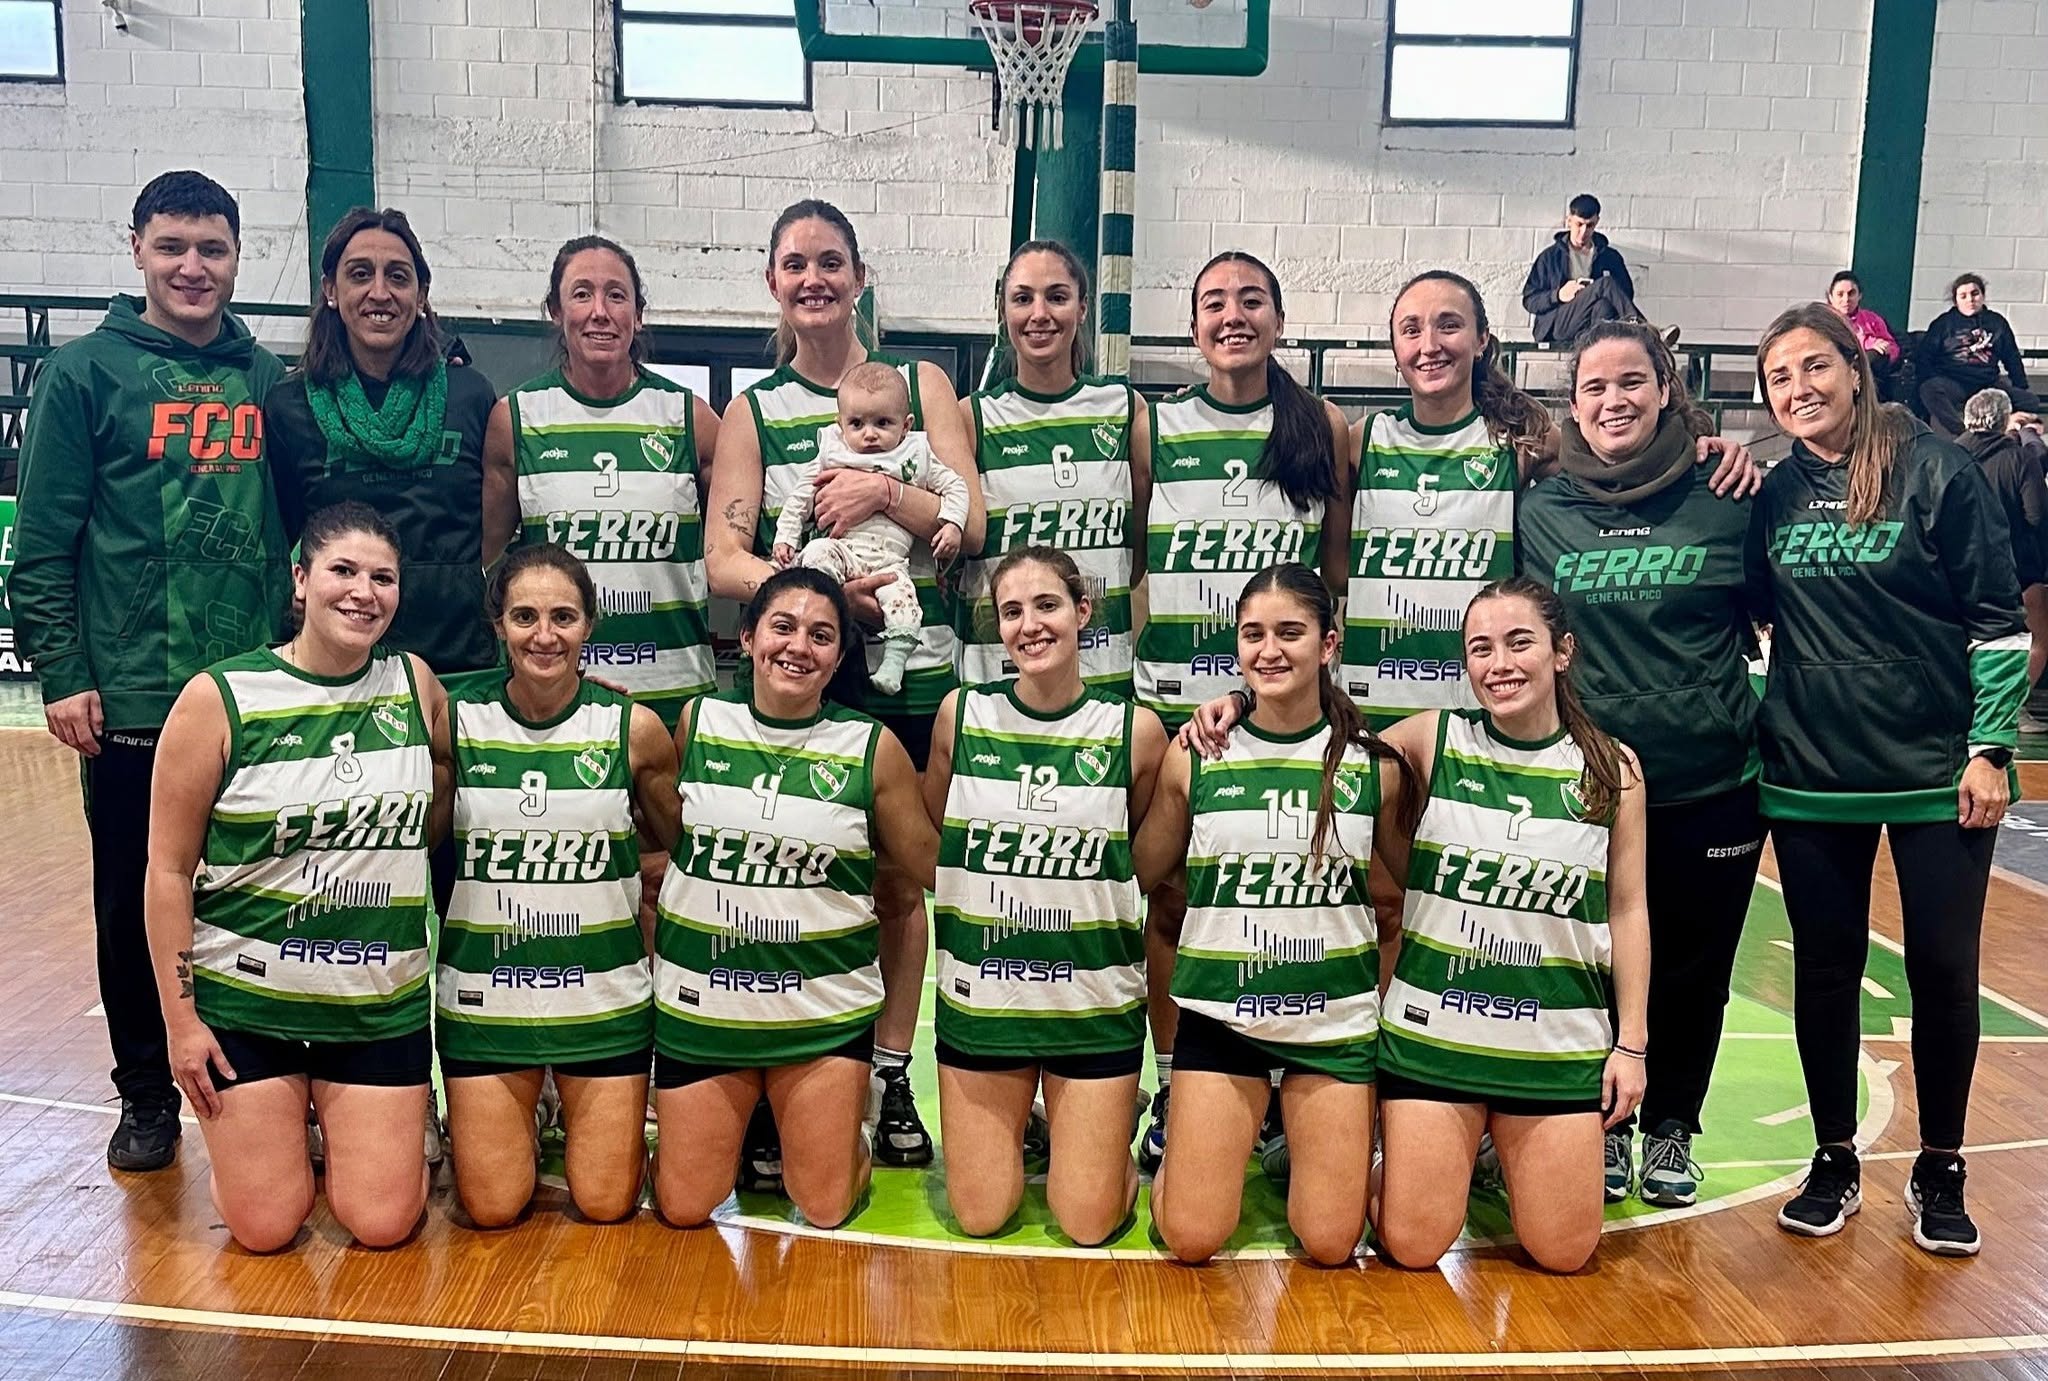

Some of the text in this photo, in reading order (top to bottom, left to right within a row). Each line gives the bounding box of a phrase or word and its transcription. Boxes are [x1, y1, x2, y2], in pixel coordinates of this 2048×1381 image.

[147, 402, 263, 460] FCO
[593, 451, 620, 498] 3
[1051, 444, 1078, 488] 6
[1222, 459, 1249, 507] 2
[1413, 473, 1440, 517] 5
[545, 510, 679, 560] FERRO
[1000, 498, 1126, 552] FERRO
[1164, 520, 1304, 571] FERRO
[1768, 521, 1905, 565] FERRO
[1357, 528, 1496, 579] FERRO
[1553, 545, 1708, 595] FERRO
[1585, 589, 1662, 604] GENERAL PICO
[579, 642, 656, 665] ARSA
[1078, 627, 1110, 650] SA
[1191, 653, 1242, 676] AR
[1377, 659, 1462, 682] ARSA
[329, 731, 363, 783] 8
[519, 770, 549, 817] 9
[750, 772, 780, 820] 4
[1014, 763, 1059, 813] 12
[274, 790, 429, 855] FERRO
[1259, 788, 1310, 840] 14
[1506, 793, 1533, 841] 7
[464, 828, 611, 881] FERRO
[685, 823, 838, 886] FERRO
[965, 817, 1110, 878] FERRO
[1212, 852, 1355, 906] FERRO
[1434, 843, 1591, 916] FERRO
[279, 938, 389, 966] ARSA
[979, 958, 1073, 983] ARSA
[491, 965, 585, 989] ARSA
[709, 967, 803, 994] ARSA
[1235, 991, 1326, 1017] ARSA
[1440, 990, 1540, 1022] ARSA
